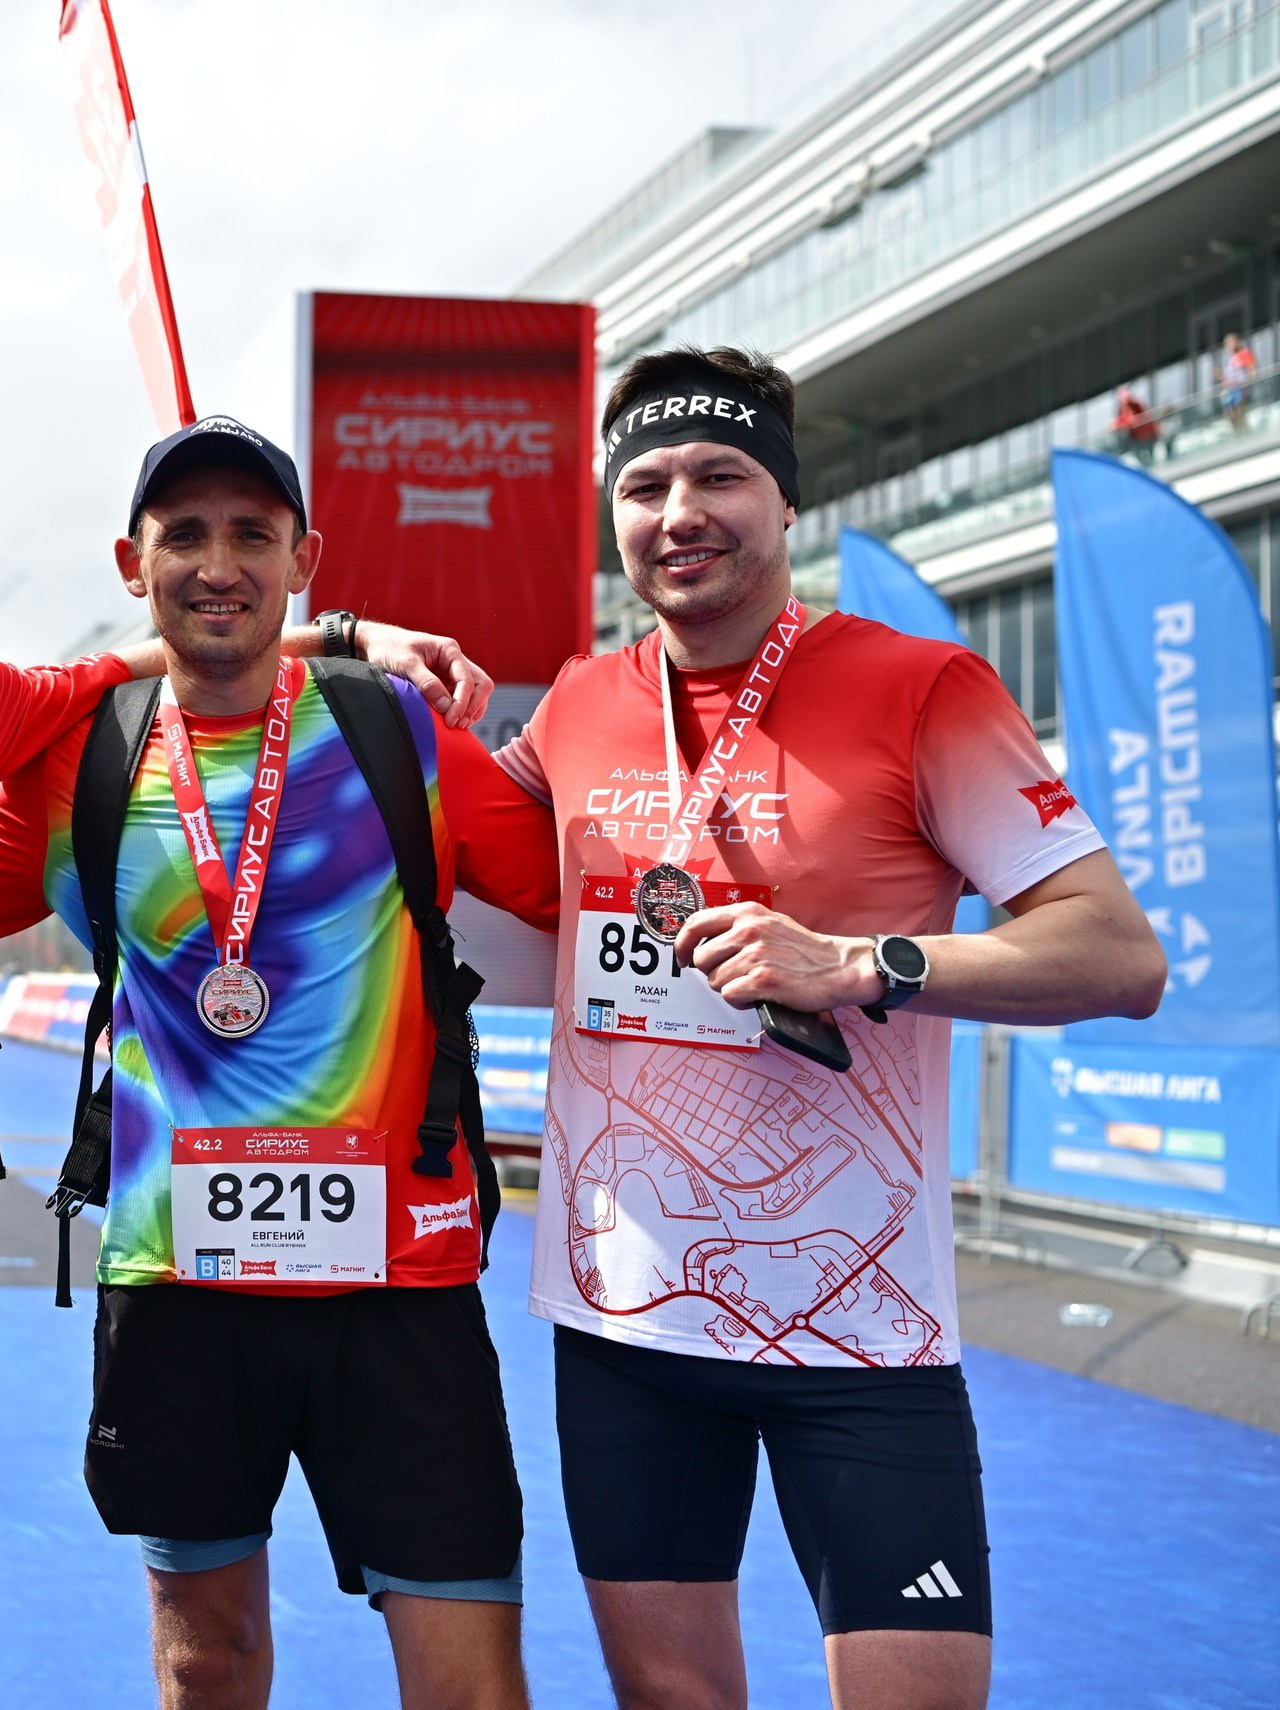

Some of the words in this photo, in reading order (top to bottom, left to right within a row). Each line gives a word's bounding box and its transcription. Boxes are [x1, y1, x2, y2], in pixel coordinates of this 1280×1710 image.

[625, 395, 758, 434] TERREX
[334, 413, 554, 455] СИРИУС
[336, 450, 553, 479] АВТОДРОМ
[172, 741, 191, 788] МАГНИТ
[586, 788, 790, 820] СИРУС
[663, 736, 738, 863] СИРИУС
[190, 816, 205, 839] Альфа
[200, 838, 210, 857] Банк
[583, 820, 780, 845] АВТОРОМ
[225, 823, 269, 965] СИРИУС
[595, 886, 614, 899] 42.2
[599, 922, 720, 978] 85
[634, 985, 668, 997] РАХАН
[604, 1010, 611, 1018] 35
[707, 1028, 736, 1036] МАГНИТ
[193, 1138, 222, 1151] 42.2
[245, 1139, 310, 1148] СИРИУС
[207, 1172, 355, 1223] 8219
[422, 1210, 457, 1228] Альфа
[252, 1230, 305, 1240] ЕВГЕНИЙ
[221, 1258, 232, 1266] 40
[90, 1438, 125, 1449] NORDSKI
